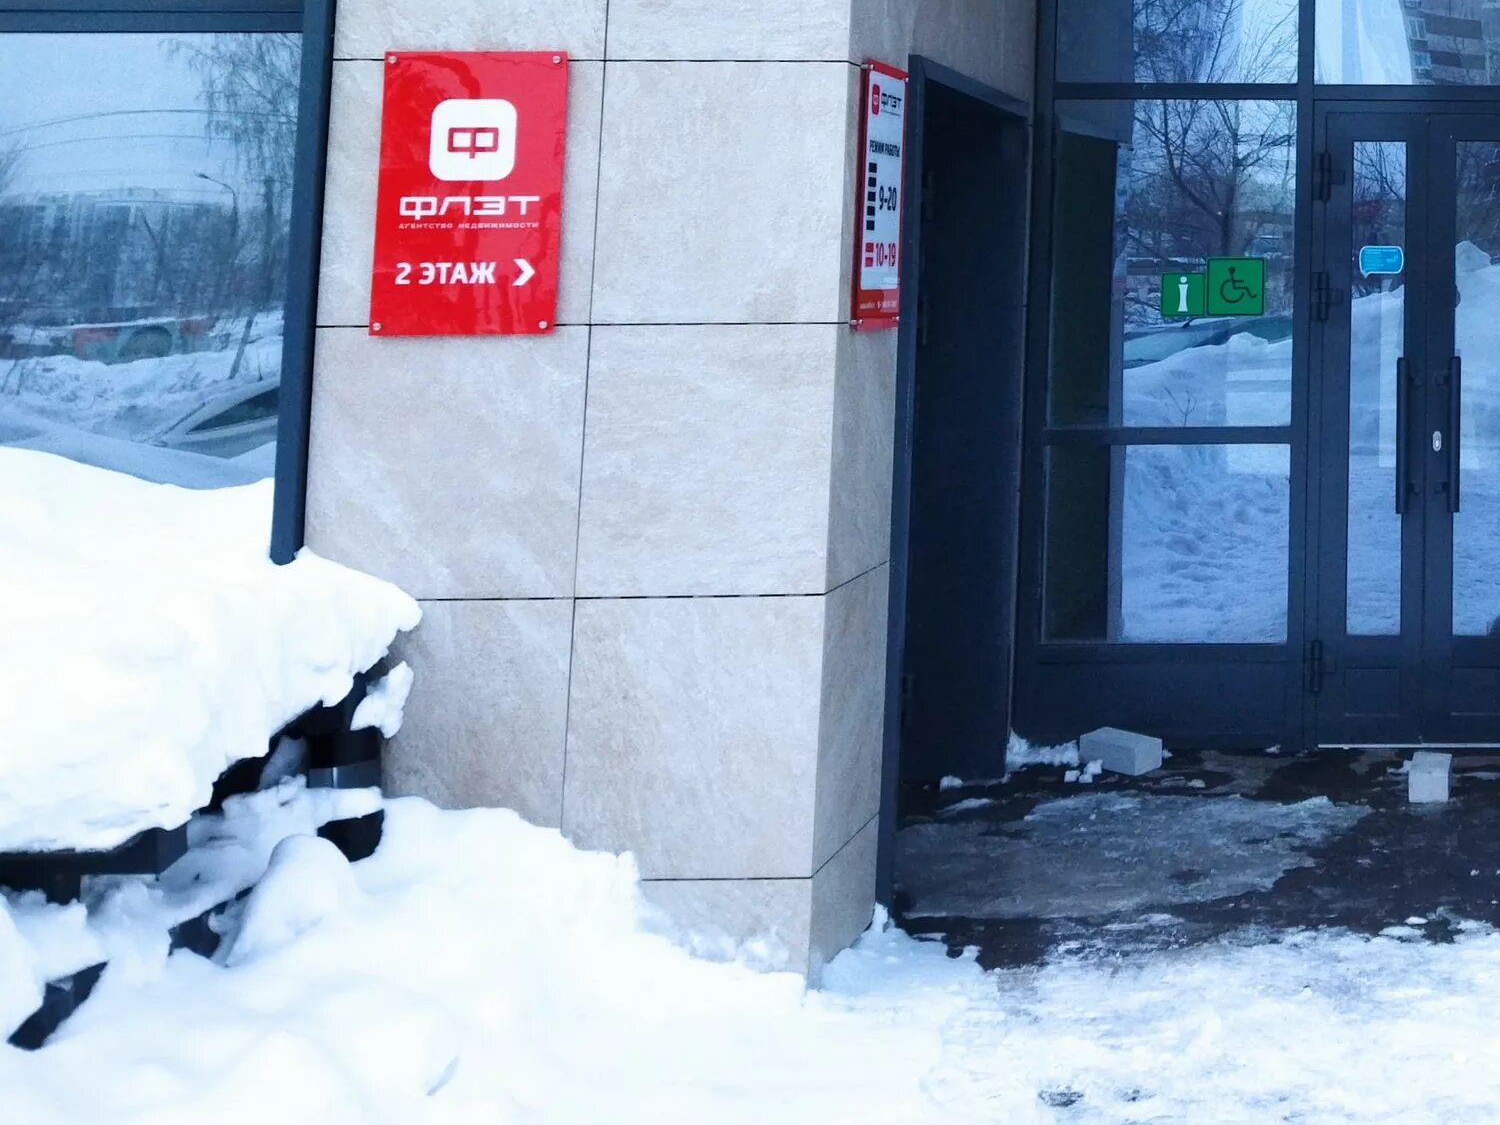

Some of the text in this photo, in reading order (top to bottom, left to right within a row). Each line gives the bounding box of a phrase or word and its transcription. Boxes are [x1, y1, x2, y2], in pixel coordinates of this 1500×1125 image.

[399, 195, 541, 221] ФЛЭТ
[878, 185, 897, 212] 9-20
[398, 221, 540, 230] АГЕНТСТВО НЕДВИЖИМОСТИ
[394, 261, 497, 285] 2 ЭТАЖ
